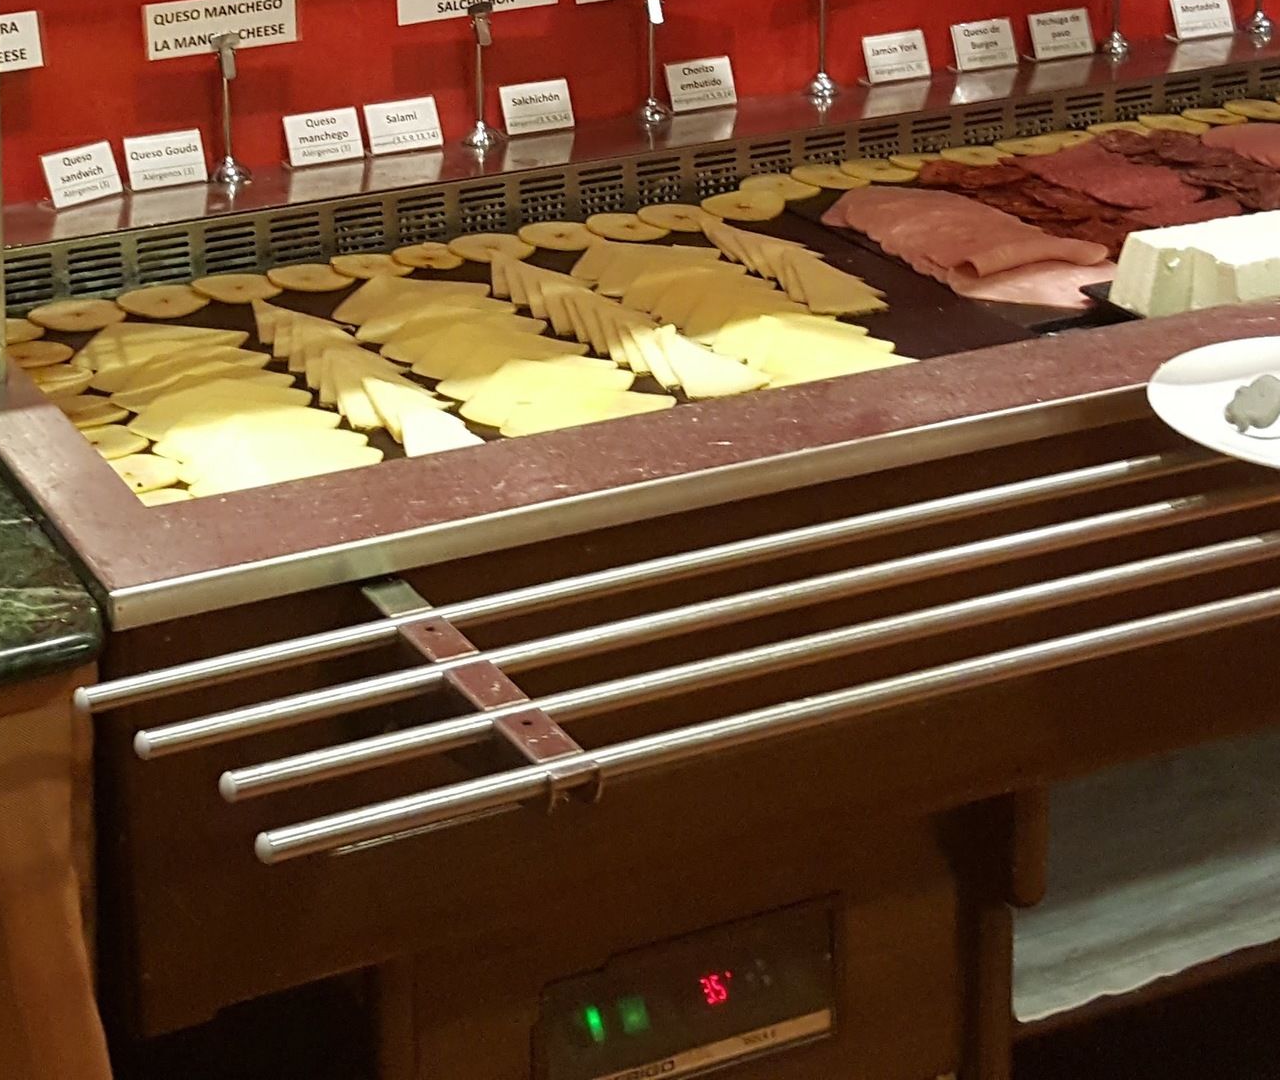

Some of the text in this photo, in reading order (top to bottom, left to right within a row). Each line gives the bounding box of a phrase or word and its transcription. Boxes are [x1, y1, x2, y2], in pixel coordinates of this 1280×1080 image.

[1181, 2, 1221, 13] Mortadela
[154, 9, 201, 26] QUESO
[154, 23, 285, 52] LA MANC CHEESE
[963, 25, 1000, 38] Queso de
[899, 41, 918, 53] York
[970, 40, 998, 51] Burgos
[682, 65, 715, 76] Chorizo
[680, 78, 722, 91] embutido
[512, 92, 560, 107] Salchichón
[305, 116, 336, 129] Queso
[385, 110, 418, 124] Salami
[298, 129, 349, 144] manchego
[62, 152, 93, 167] Queso
[130, 143, 199, 162] Queso Gouda
[60, 166, 104, 184] sandwich
